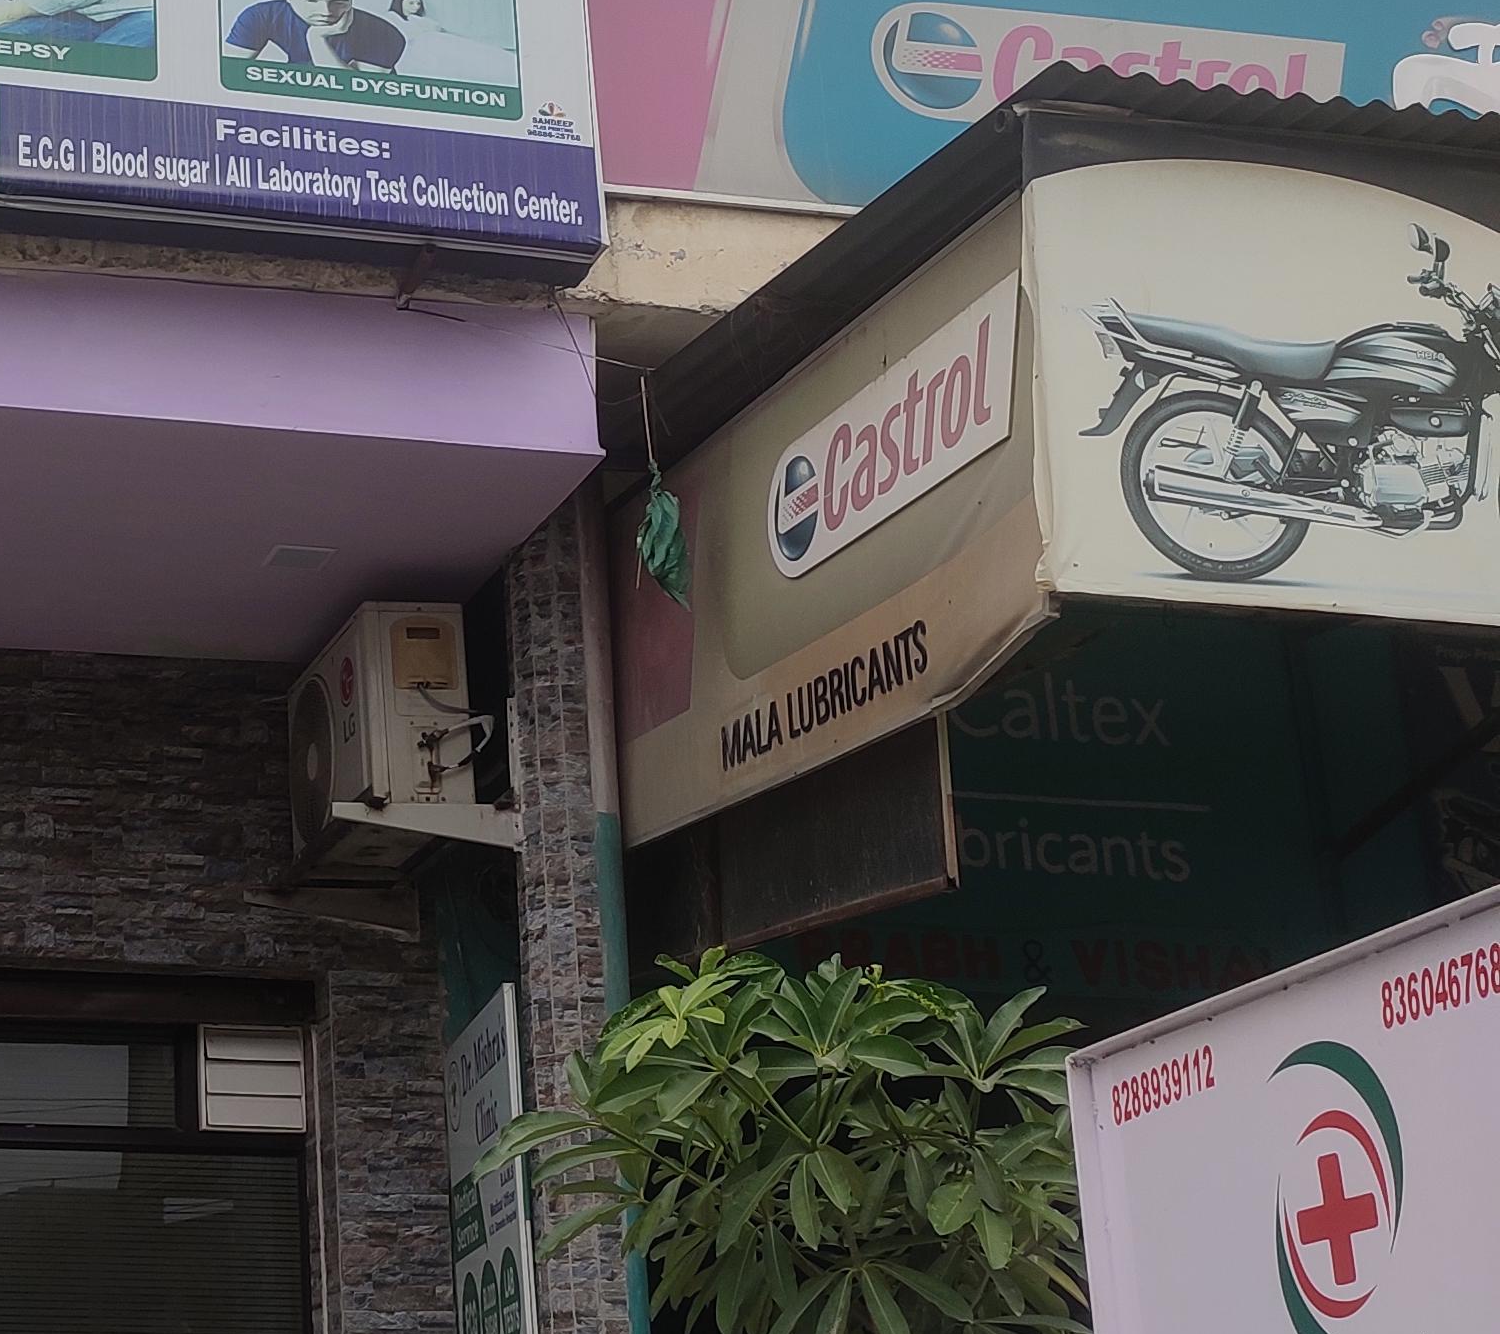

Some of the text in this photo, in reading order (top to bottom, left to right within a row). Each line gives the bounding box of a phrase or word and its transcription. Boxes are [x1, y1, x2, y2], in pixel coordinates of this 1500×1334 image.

[245, 66, 506, 108] SEXUAL DYSFUNTION
[215, 118, 392, 159] Facilities:
[18, 134, 584, 226] E.C.G Blood sugar All Laboratory Test Collection Center.
[1416, 350, 1446, 363] Hero
[820, 313, 992, 532] Castrol
[720, 619, 928, 772] MALA LUBRICANTS
[950, 671, 1172, 748] Caltex
[342, 718, 356, 744] LG
[1069, 937, 1272, 989] VISHA
[1381, 942, 1500, 1029] 836046768
[475, 1089, 498, 1145] Clinic
[1112, 1044, 1216, 1126] 8288939112
